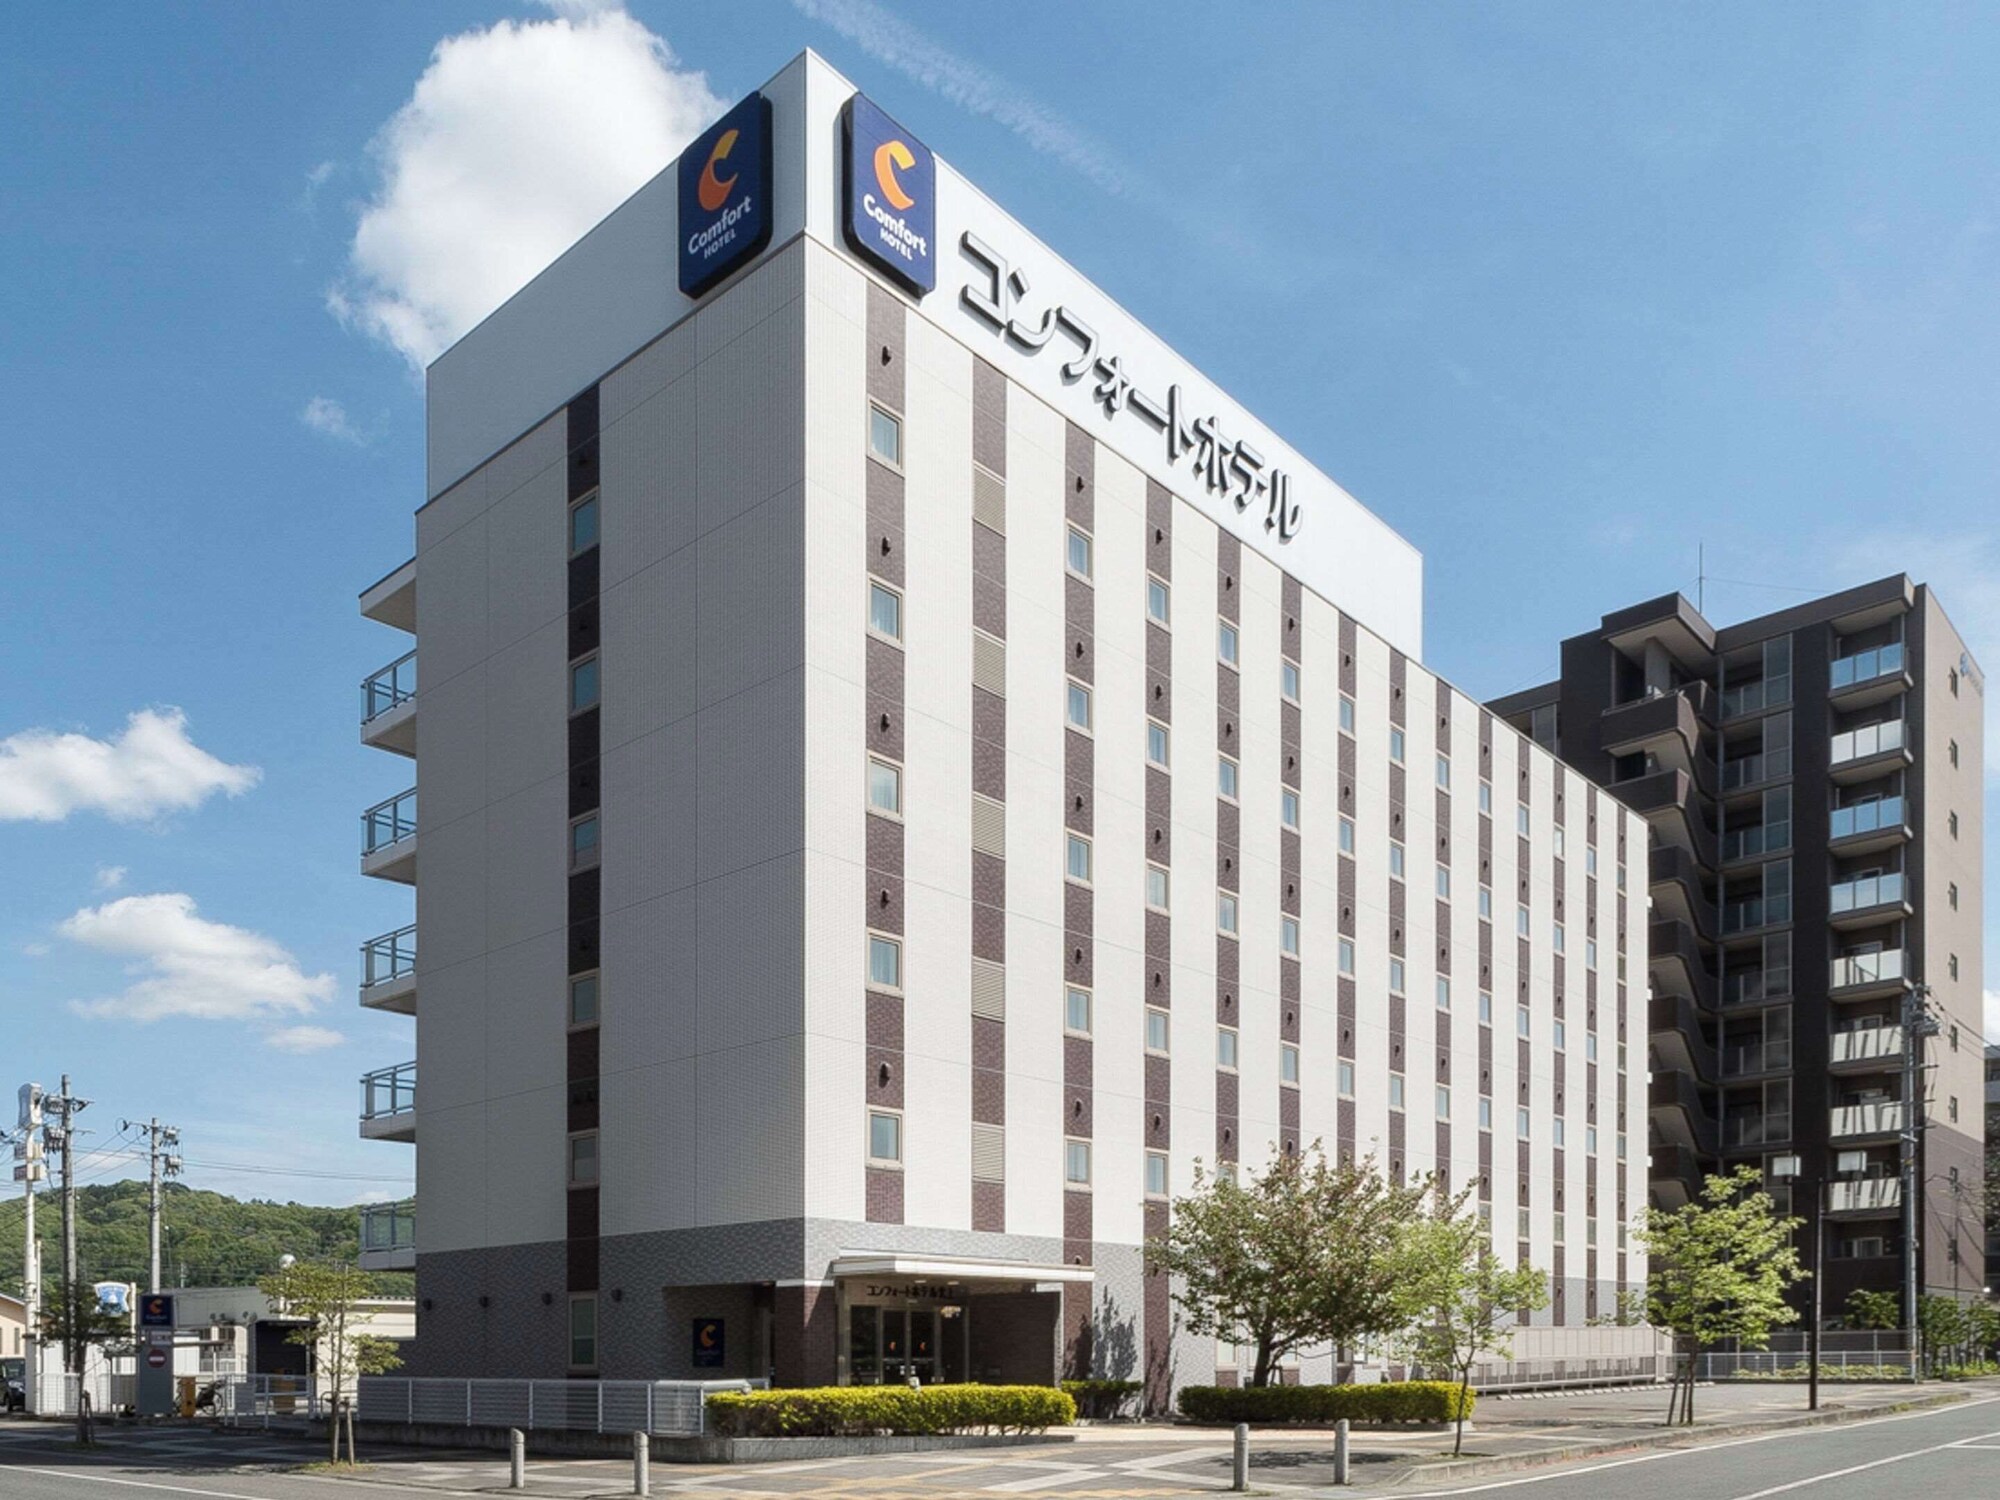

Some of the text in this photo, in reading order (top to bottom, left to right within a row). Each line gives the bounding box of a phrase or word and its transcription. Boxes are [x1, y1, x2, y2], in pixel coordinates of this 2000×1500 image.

[688, 195, 751, 255] Comfort
[703, 228, 736, 259] HOTEL
[863, 193, 926, 256] Comfort
[880, 228, 912, 260] HOTEL
[959, 230, 1302, 543] コンフォートホテル
